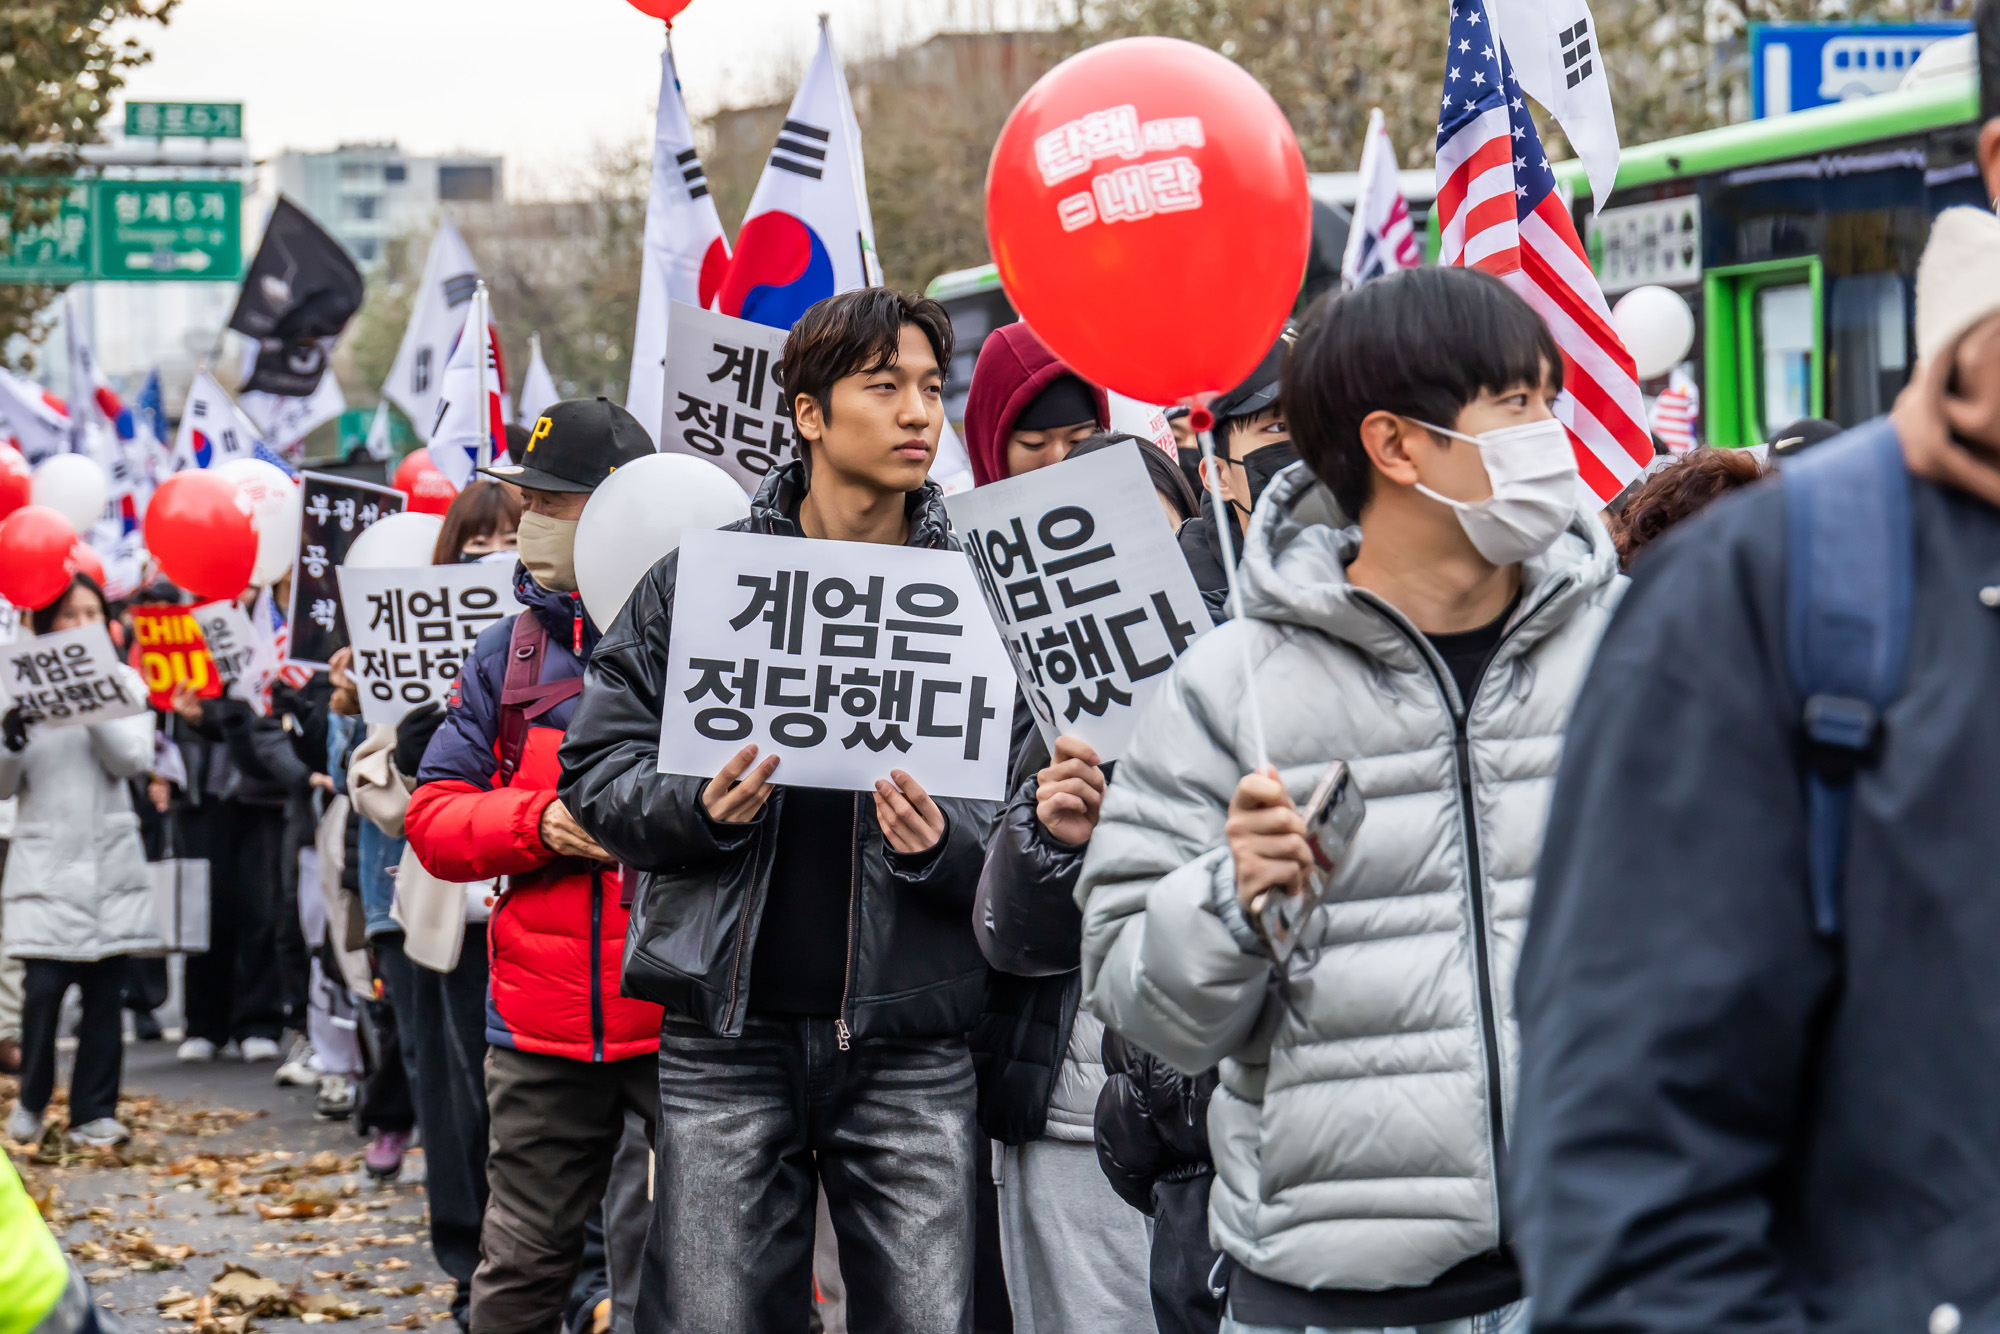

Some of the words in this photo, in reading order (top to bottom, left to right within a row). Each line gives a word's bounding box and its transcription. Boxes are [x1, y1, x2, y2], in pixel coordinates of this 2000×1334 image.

[1035, 105, 1142, 186] 탄핵
[1142, 117, 1204, 150] 세력
[527, 416, 553, 452] P
[674, 391, 799, 476] 정당
[367, 586, 504, 643] 계엄은
[729, 569, 963, 665] 계엄은
[11, 644, 95, 685] 계엄은
[1002, 590, 1196, 727] 당했다
[683, 657, 995, 760] 정당했다
